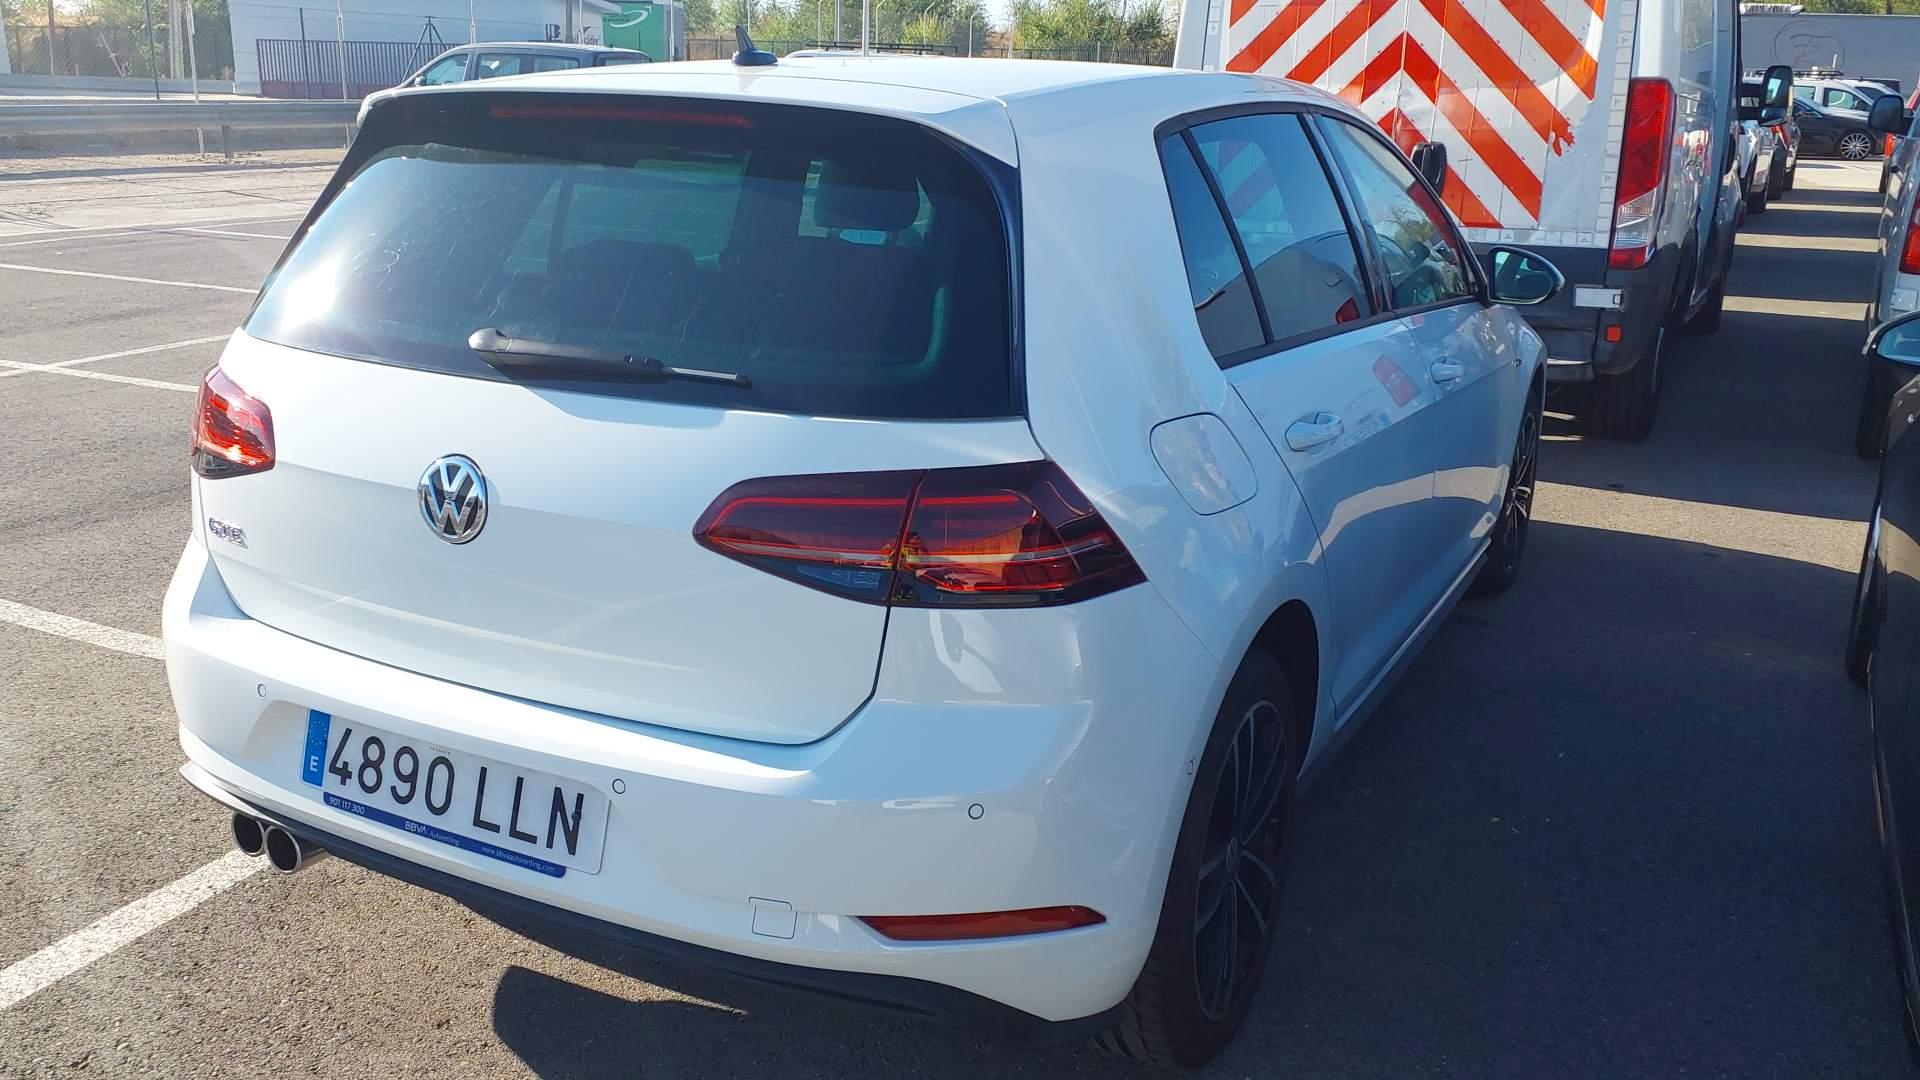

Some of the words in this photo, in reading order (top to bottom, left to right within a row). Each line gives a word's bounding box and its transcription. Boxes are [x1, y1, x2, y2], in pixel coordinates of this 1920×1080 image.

[309, 755, 319, 773] E
[328, 728, 455, 816] 4890
[472, 766, 585, 856] LLN
[329, 796, 341, 807] 901
[342, 800, 351, 810] 117
[351, 804, 365, 815] 300
[404, 820, 427, 834] BBVA
